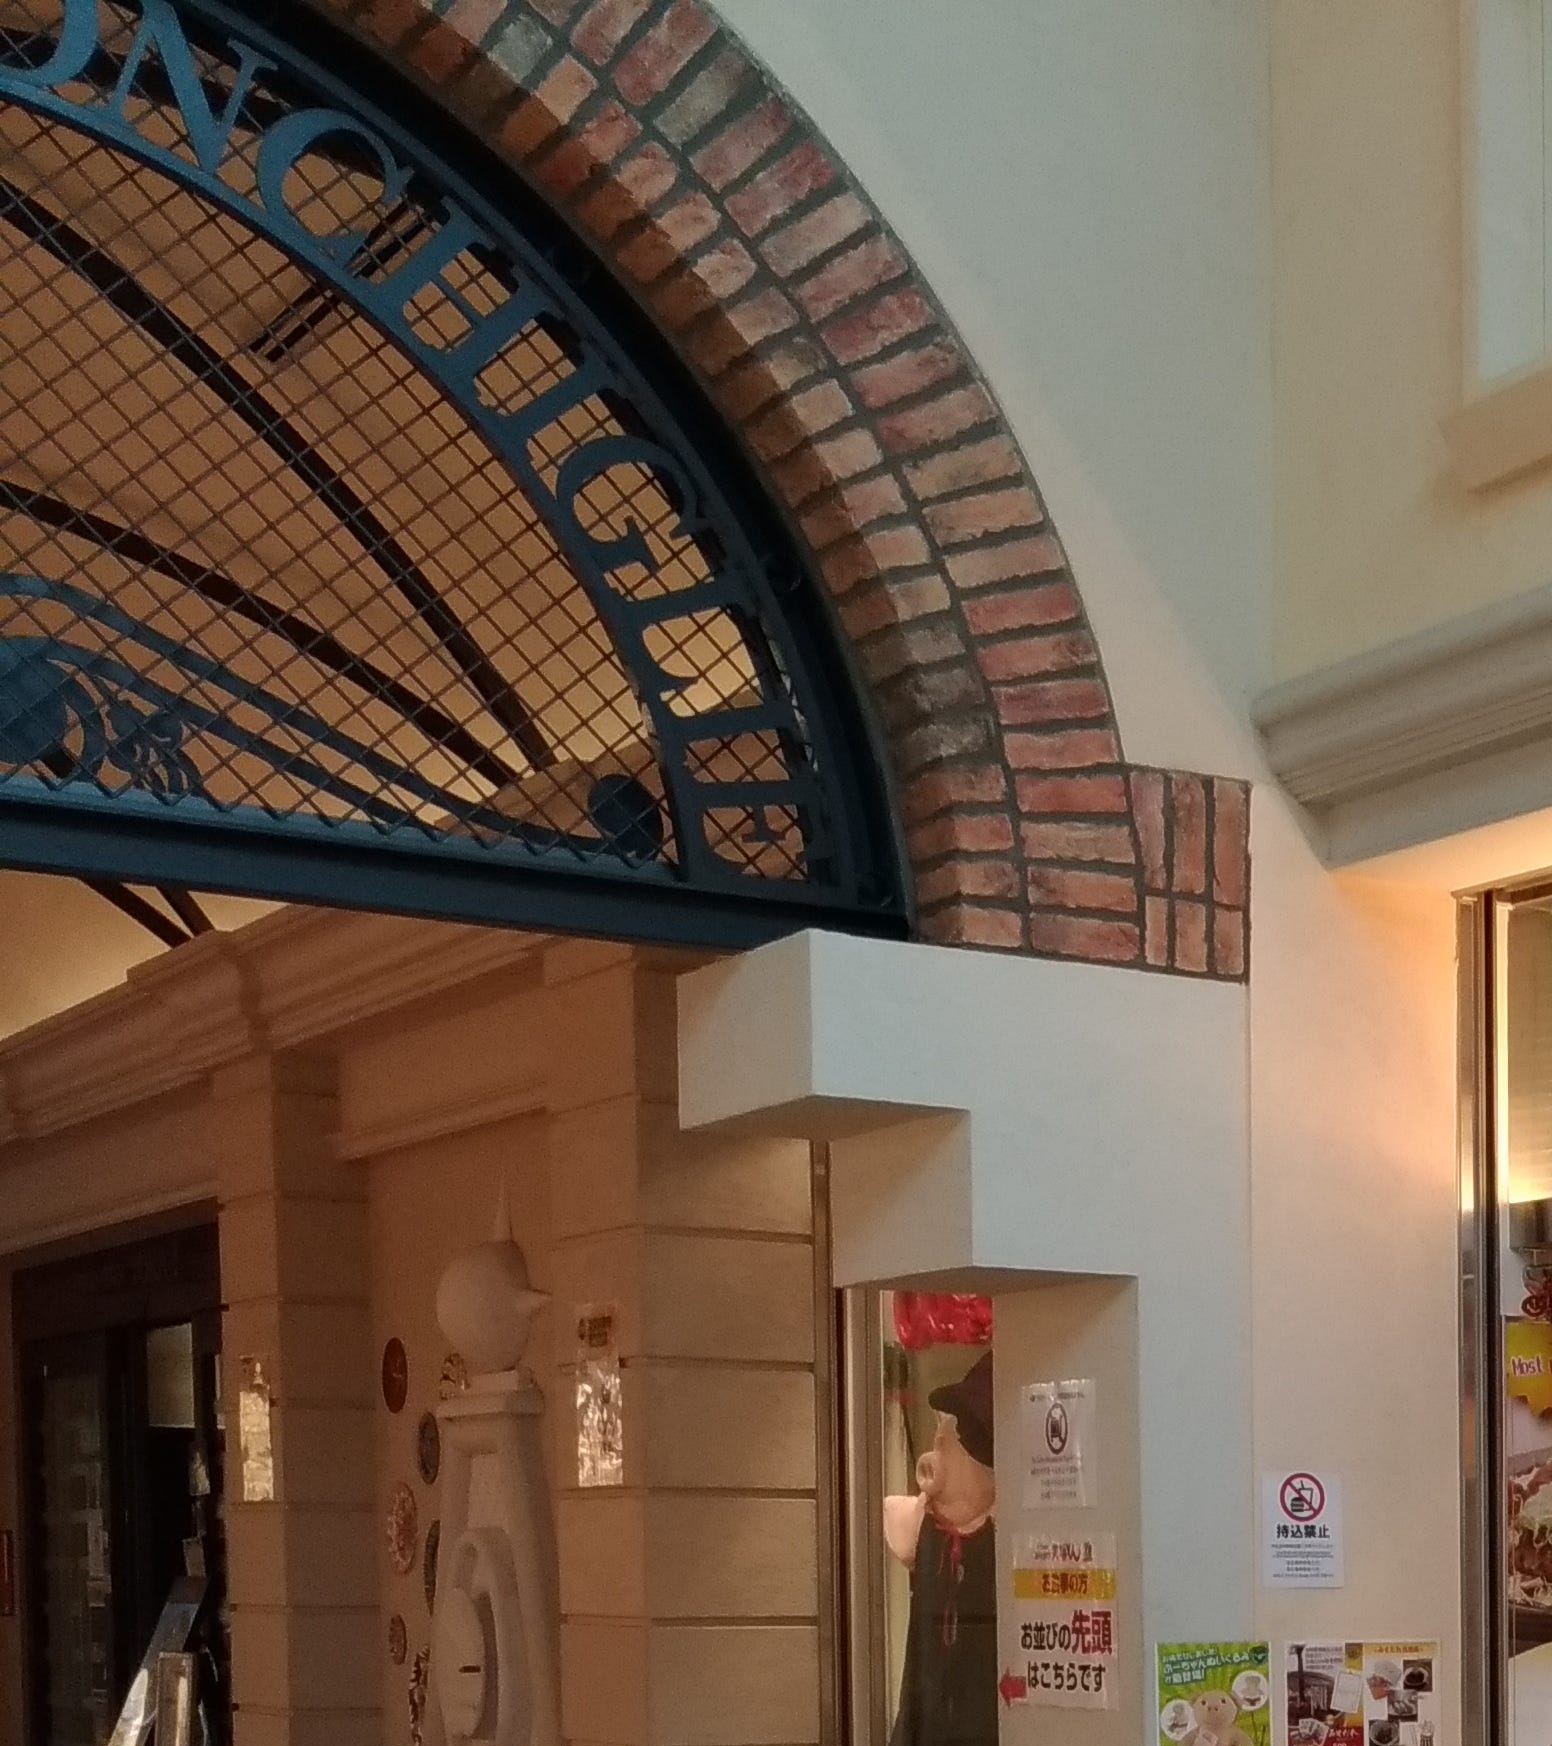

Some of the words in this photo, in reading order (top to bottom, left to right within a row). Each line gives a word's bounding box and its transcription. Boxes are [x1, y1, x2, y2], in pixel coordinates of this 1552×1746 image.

[1276, 1523, 1330, 1540] 持込禁止
[1020, 1610, 1113, 1656] お並びの先頭
[1027, 1660, 1107, 1693] はこちらです
